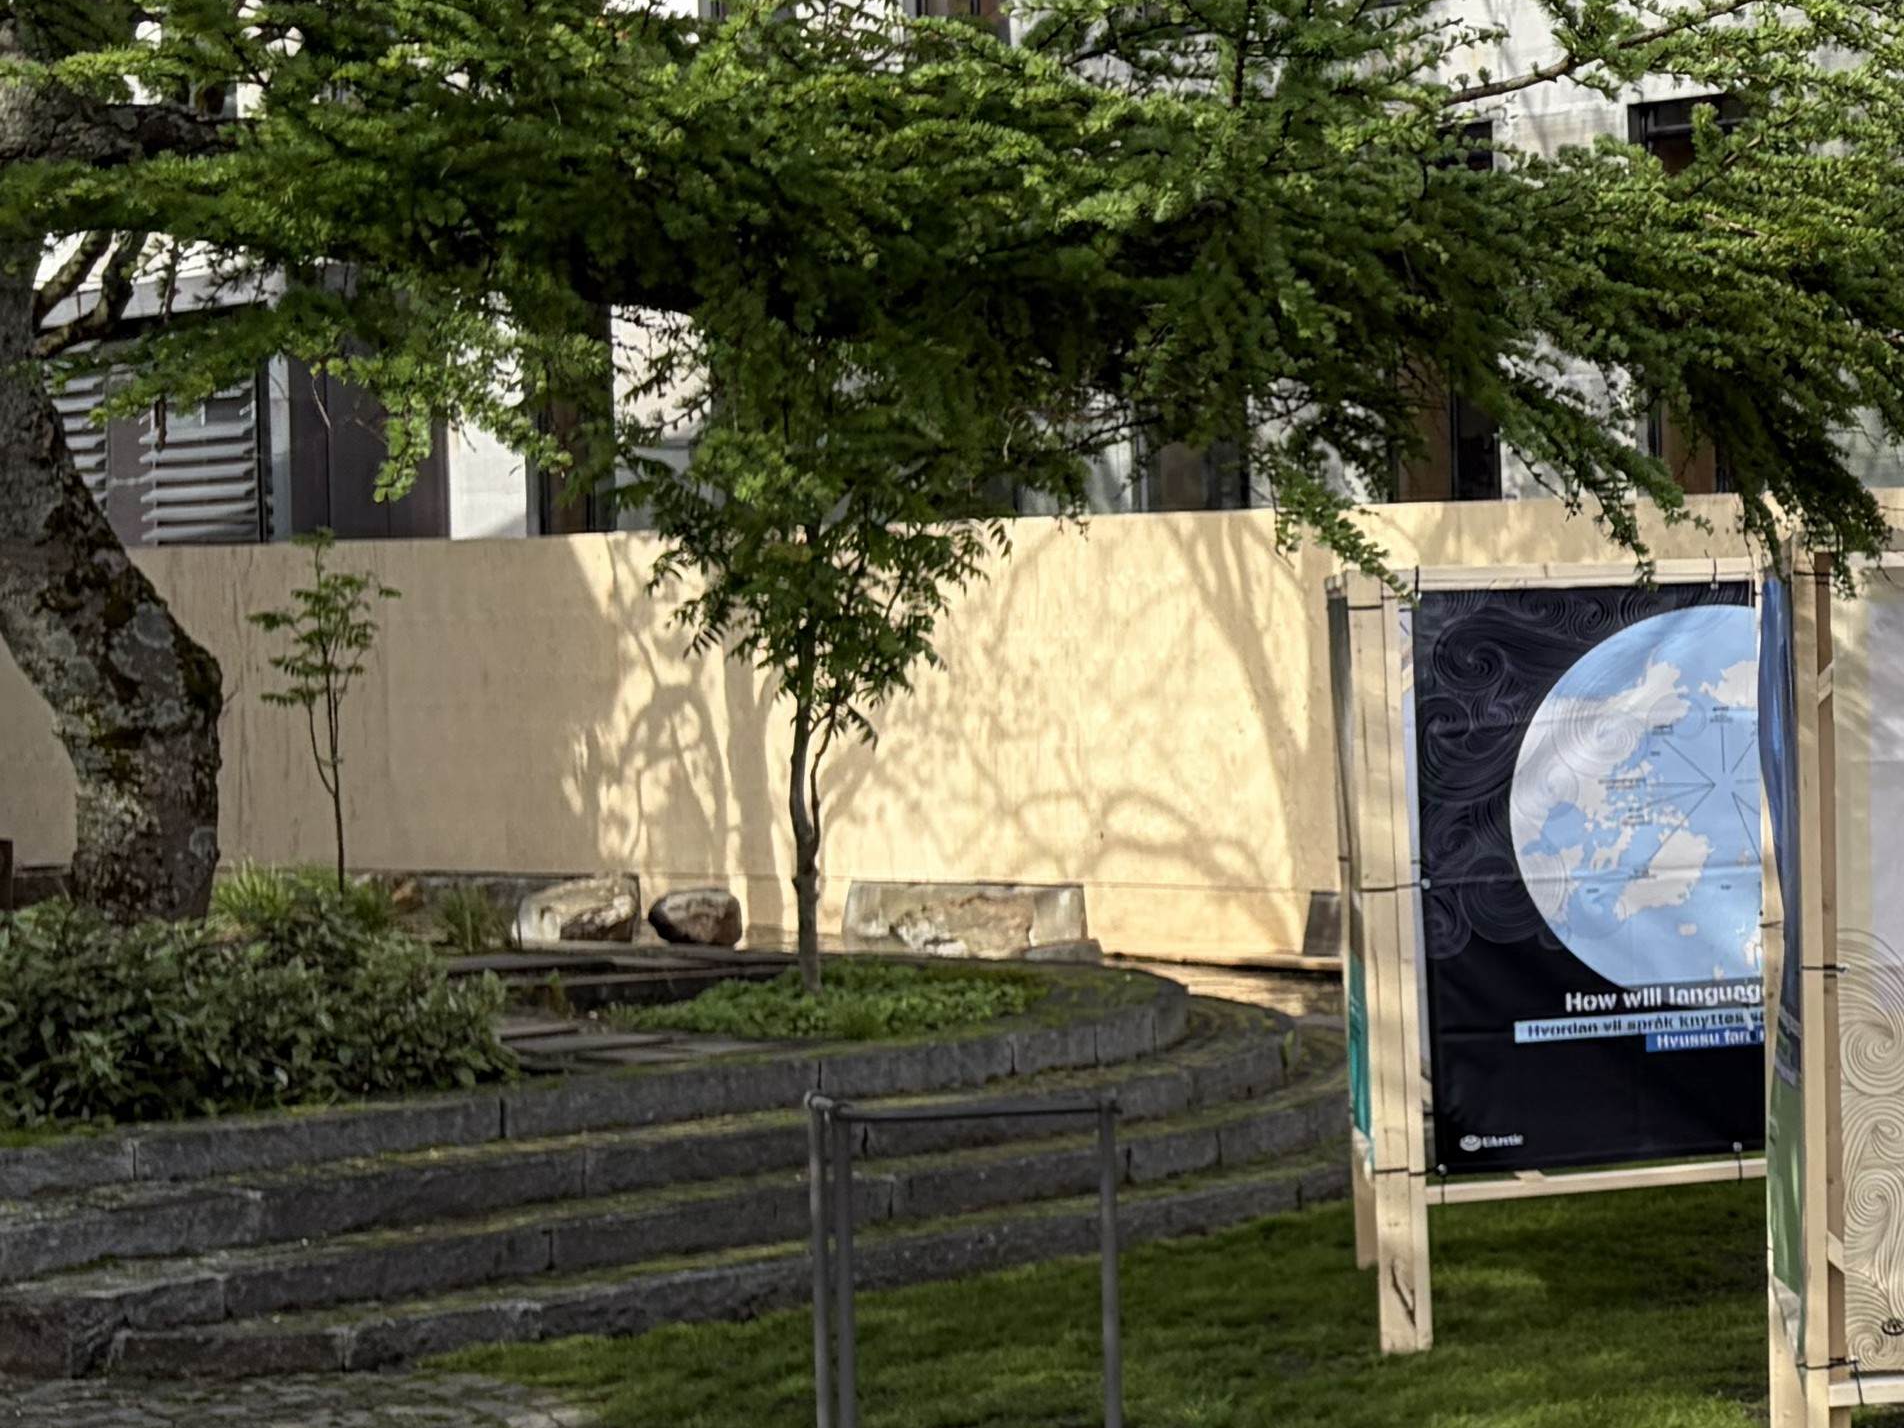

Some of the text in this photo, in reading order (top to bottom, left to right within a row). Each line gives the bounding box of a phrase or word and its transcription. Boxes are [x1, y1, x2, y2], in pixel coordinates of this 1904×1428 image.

[1564, 983, 1764, 1013] How will languag
[1528, 1021, 1598, 1038] Hvordan
[1602, 1020, 1622, 1033] vil
